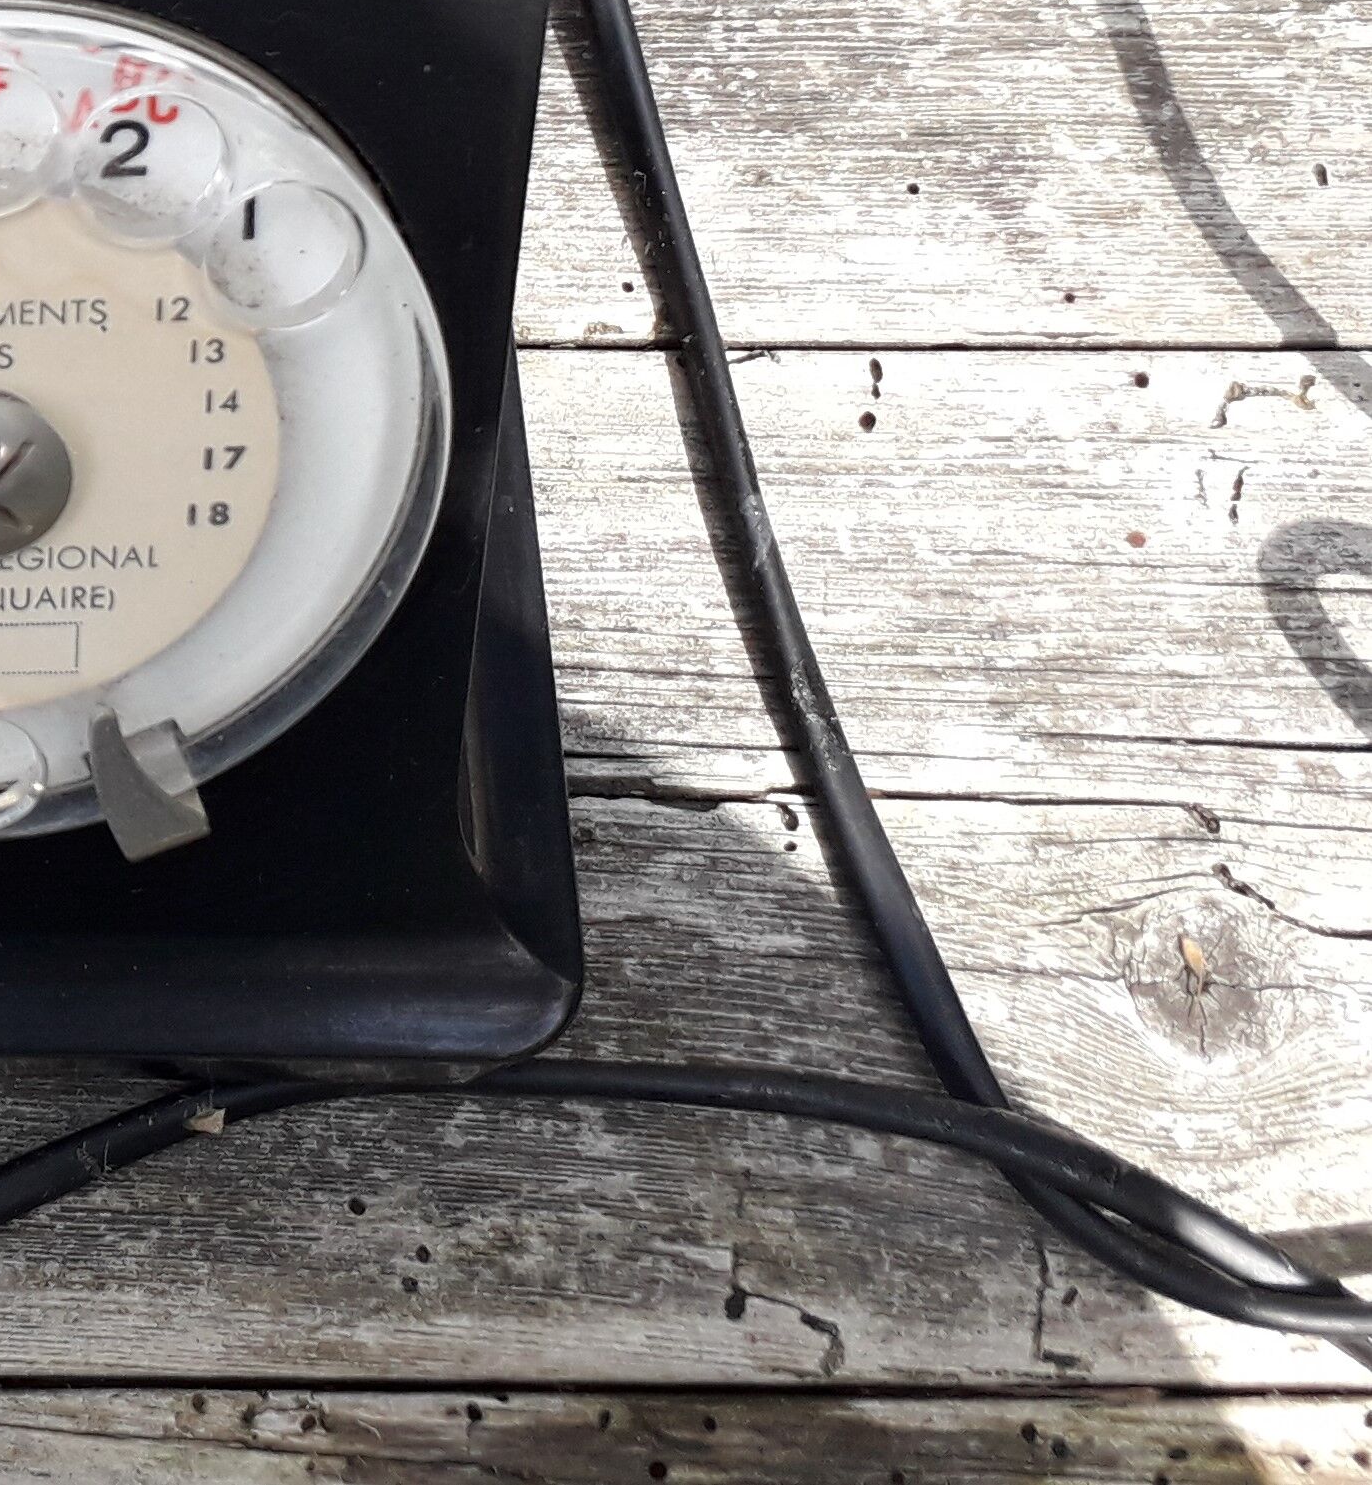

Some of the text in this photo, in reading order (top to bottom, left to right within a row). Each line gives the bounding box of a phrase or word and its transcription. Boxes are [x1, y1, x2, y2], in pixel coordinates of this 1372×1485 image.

[100, 119, 150, 179] 2
[156, 297, 191, 324] 12
[191, 339, 226, 365] 13
[206, 390, 241, 415] 14
[204, 446, 248, 472] 17
[187, 502, 231, 528] 18
